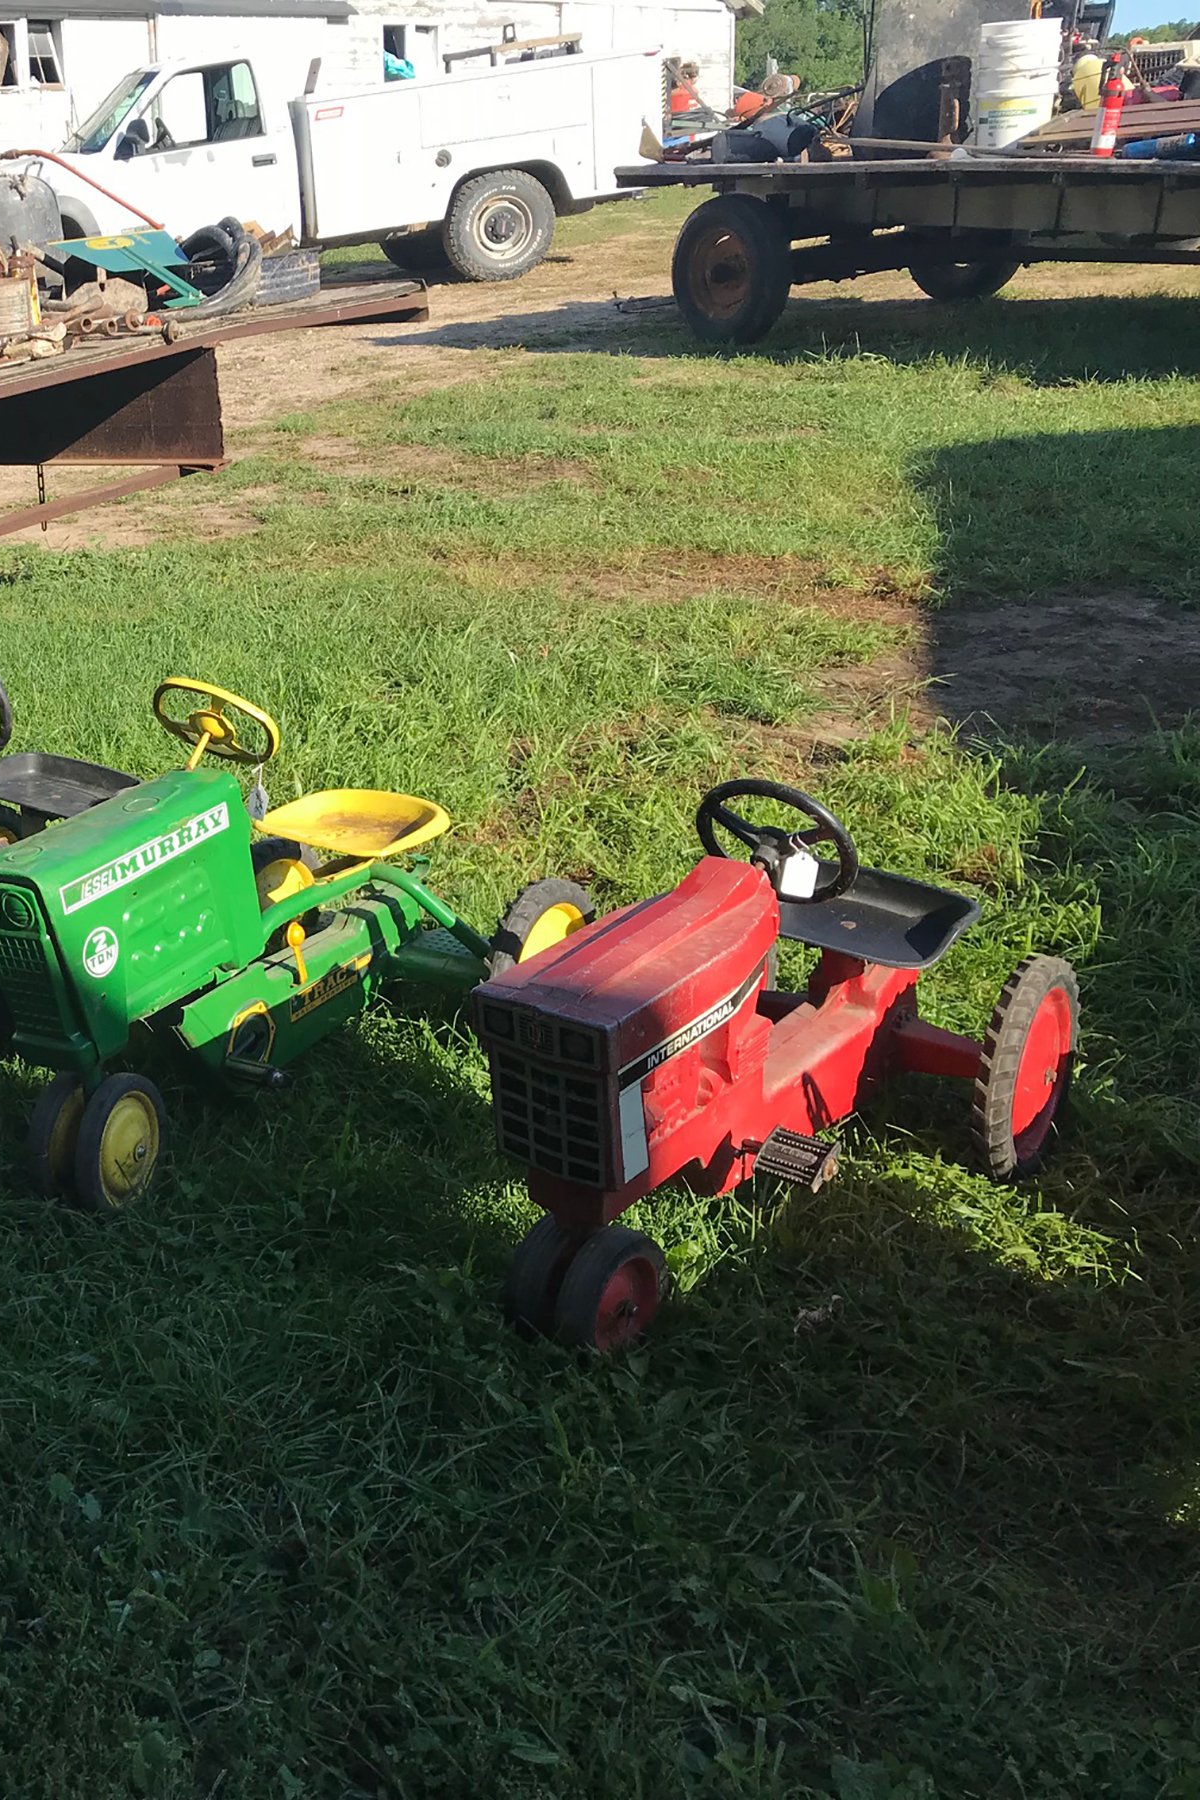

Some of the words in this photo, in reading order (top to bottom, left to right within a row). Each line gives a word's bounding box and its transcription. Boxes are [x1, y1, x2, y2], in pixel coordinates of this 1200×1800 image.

[76, 868, 117, 902] IESEL
[116, 808, 224, 880] MURRAY
[89, 950, 114, 969] TON
[92, 931, 108, 954] 2
[300, 965, 349, 1006] TRAC
[646, 1000, 735, 1069] INTERNATIONAL
